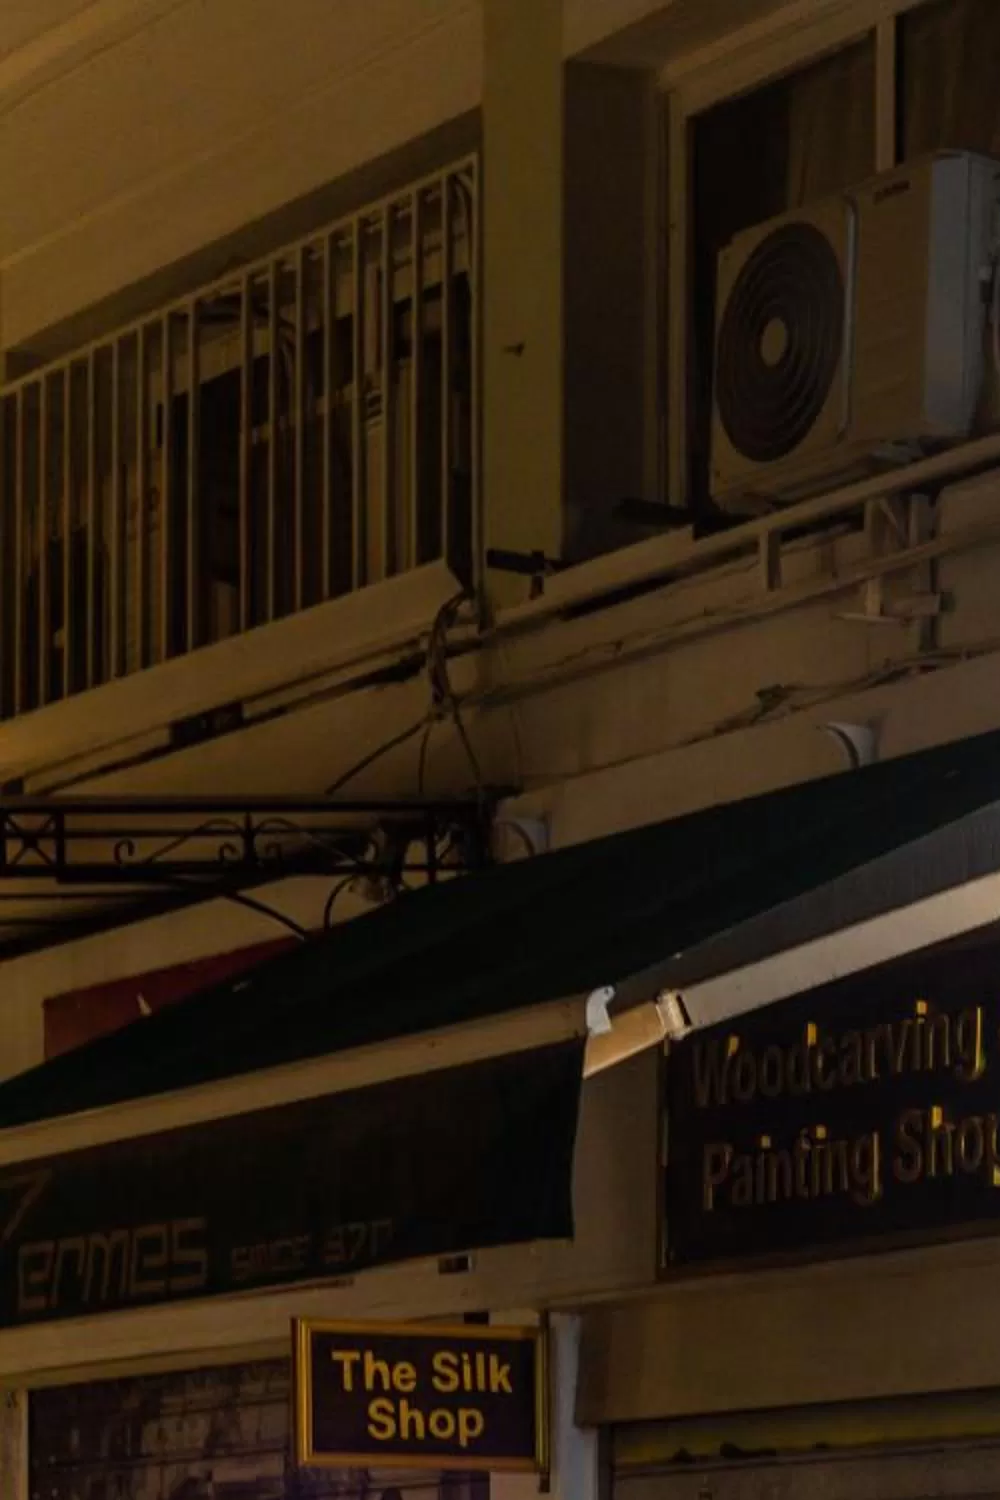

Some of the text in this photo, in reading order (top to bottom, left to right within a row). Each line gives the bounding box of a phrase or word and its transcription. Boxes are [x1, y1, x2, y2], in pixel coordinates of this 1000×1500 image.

[691, 997, 987, 1108] Woodcarving
[702, 1123, 884, 1213] Painting
[331, 1348, 513, 1395] The Silk
[366, 1397, 486, 1447] Shop
